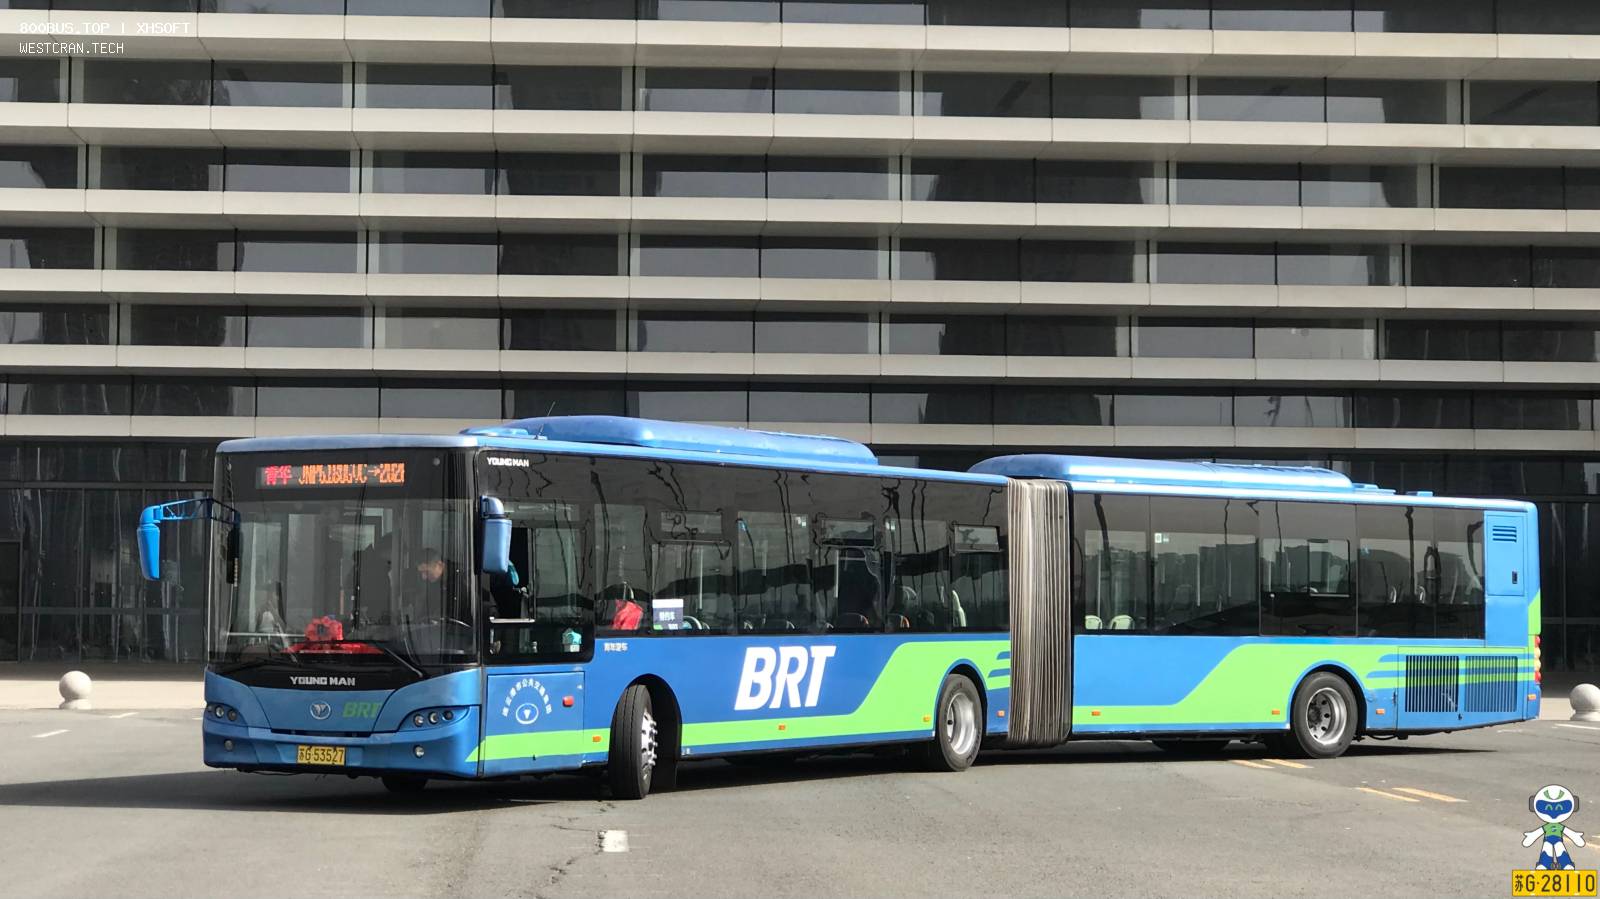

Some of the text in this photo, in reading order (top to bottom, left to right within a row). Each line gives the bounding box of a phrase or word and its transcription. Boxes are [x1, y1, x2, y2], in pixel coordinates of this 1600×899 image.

[487, 457, 530, 467] YOUNG MAN
[290, 676, 356, 686] YOUNG MAN
[734, 645, 837, 711] BRT
[342, 702, 381, 718] BRT
